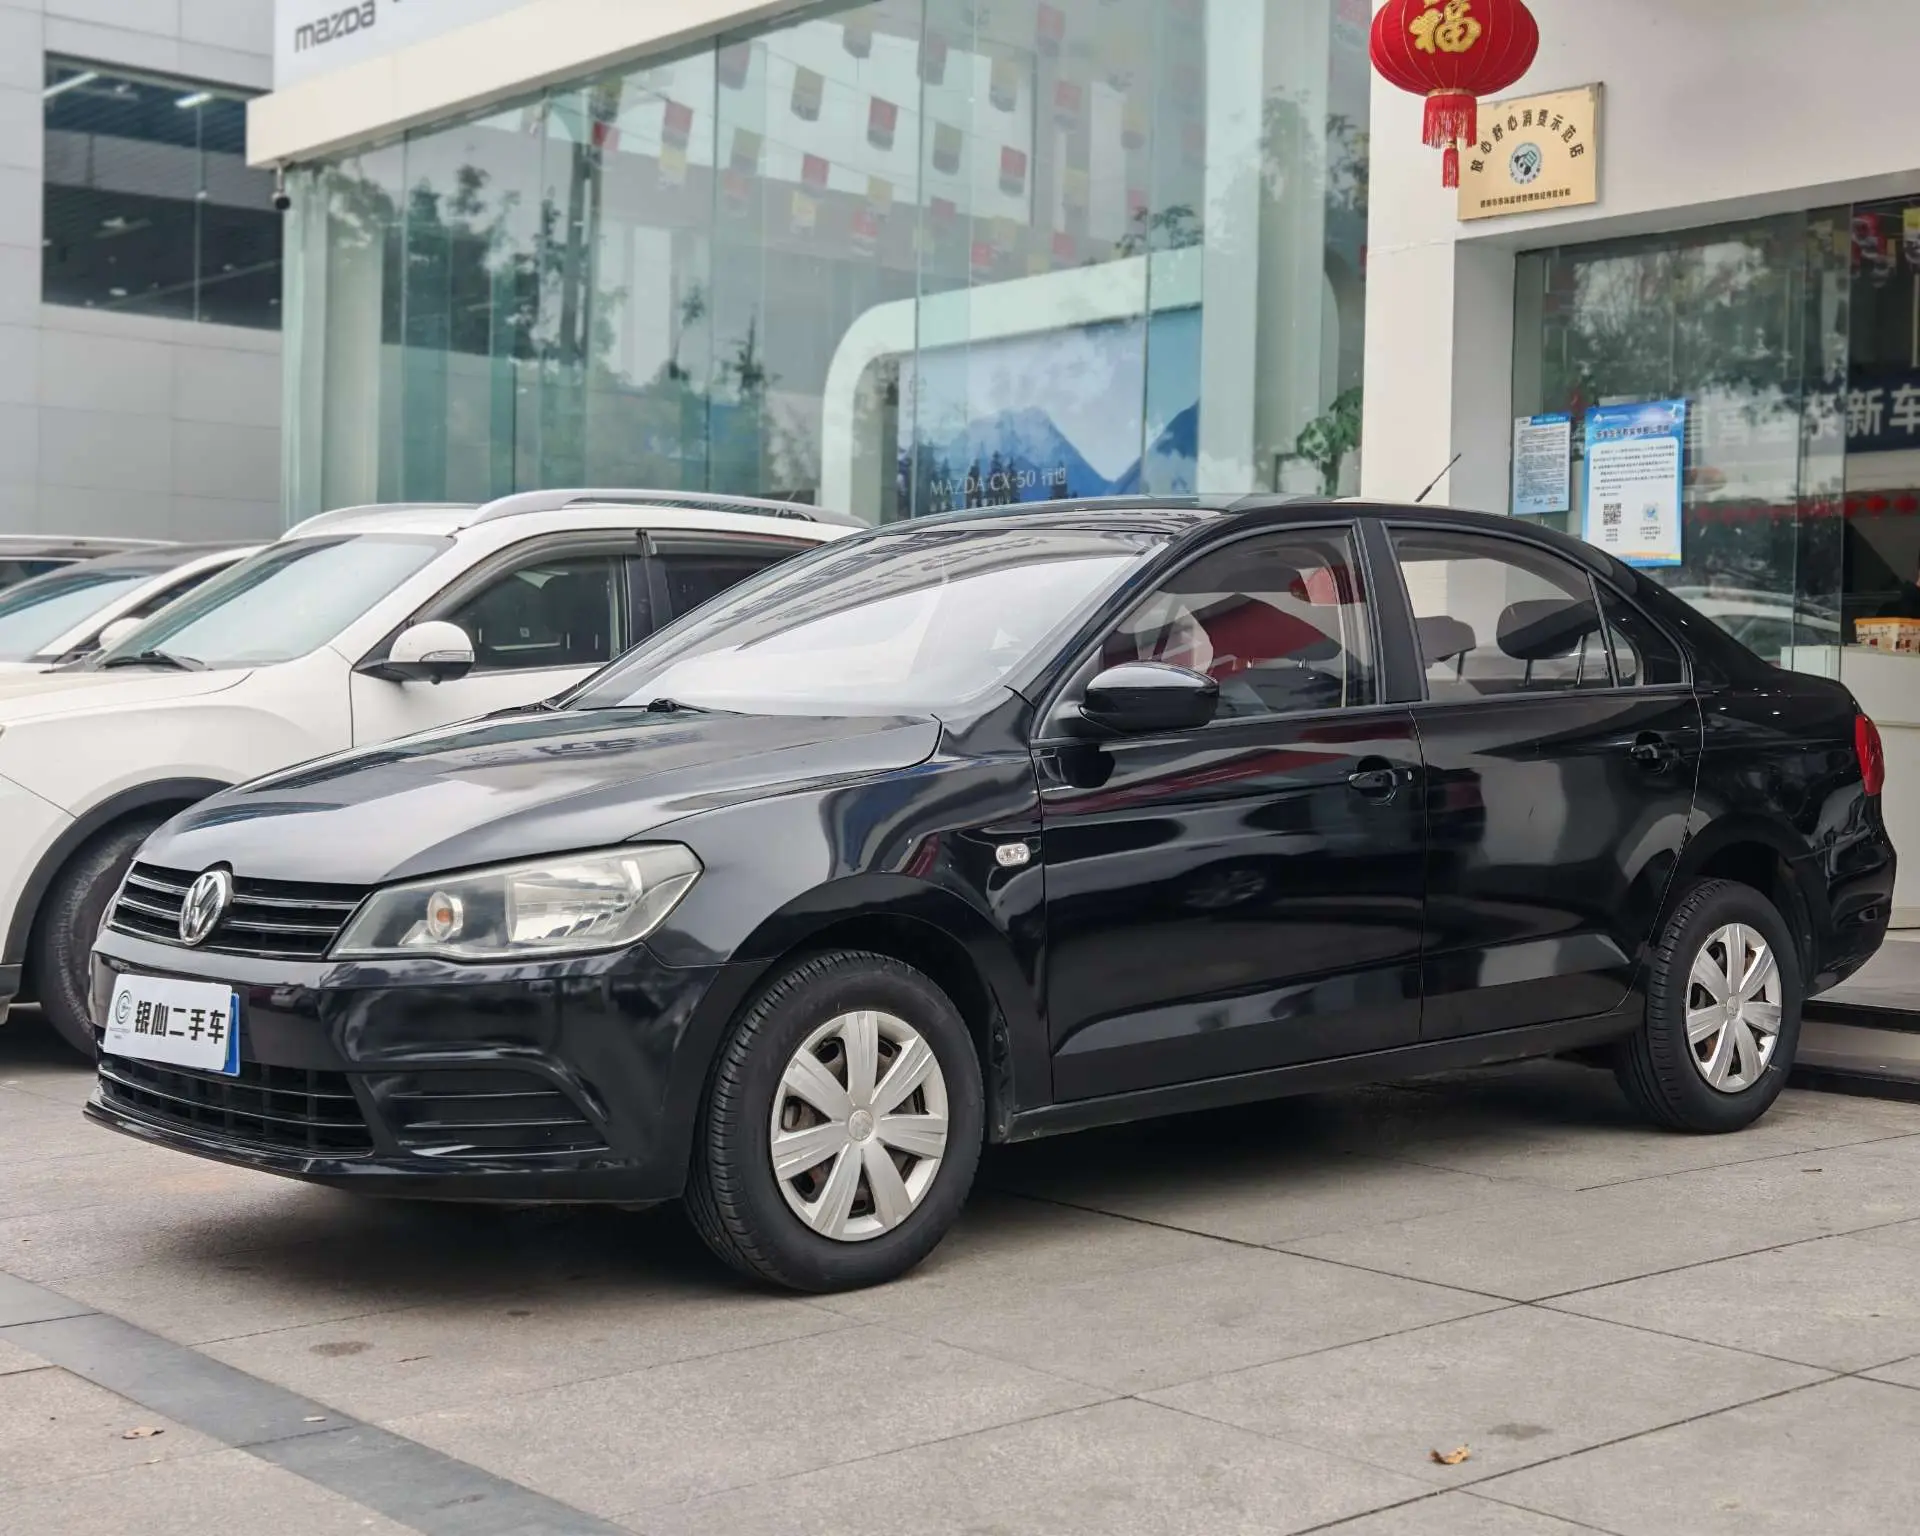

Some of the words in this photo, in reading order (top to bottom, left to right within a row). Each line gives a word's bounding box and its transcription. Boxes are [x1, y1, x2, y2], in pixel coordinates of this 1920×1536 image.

[1408, 0, 1482, 53] 福
[1470, 108, 1585, 173] 放心舒心消费示范店
[929, 475, 985, 496] MAZDA
[990, 469, 1036, 491] CX-50
